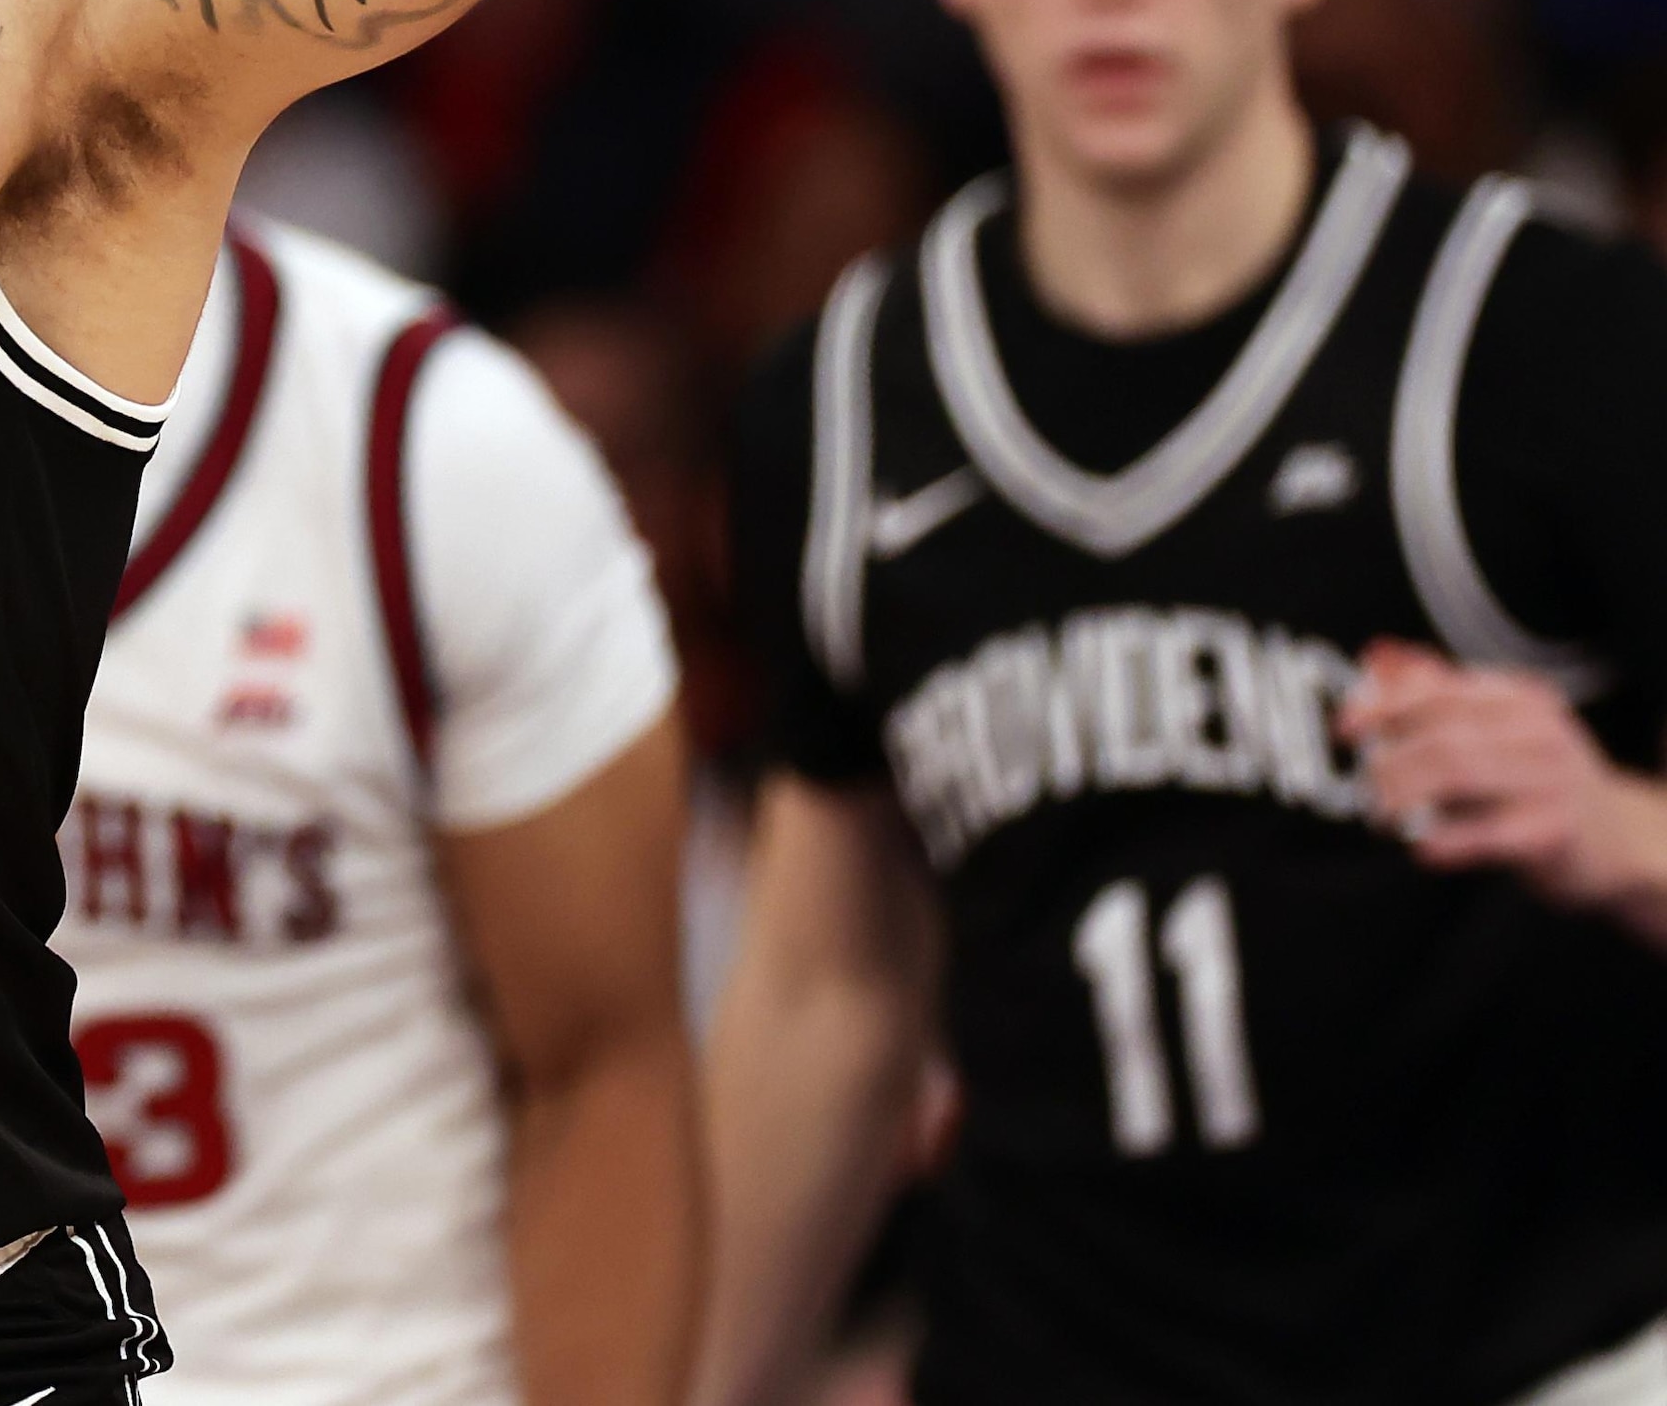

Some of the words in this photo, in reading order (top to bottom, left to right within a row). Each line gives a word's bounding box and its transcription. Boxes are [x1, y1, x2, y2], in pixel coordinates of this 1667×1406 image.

[79, 796, 340, 944] HN'S
[881, 602, 1379, 874] PROVIDENC
[1072, 870, 1261, 1154] 11
